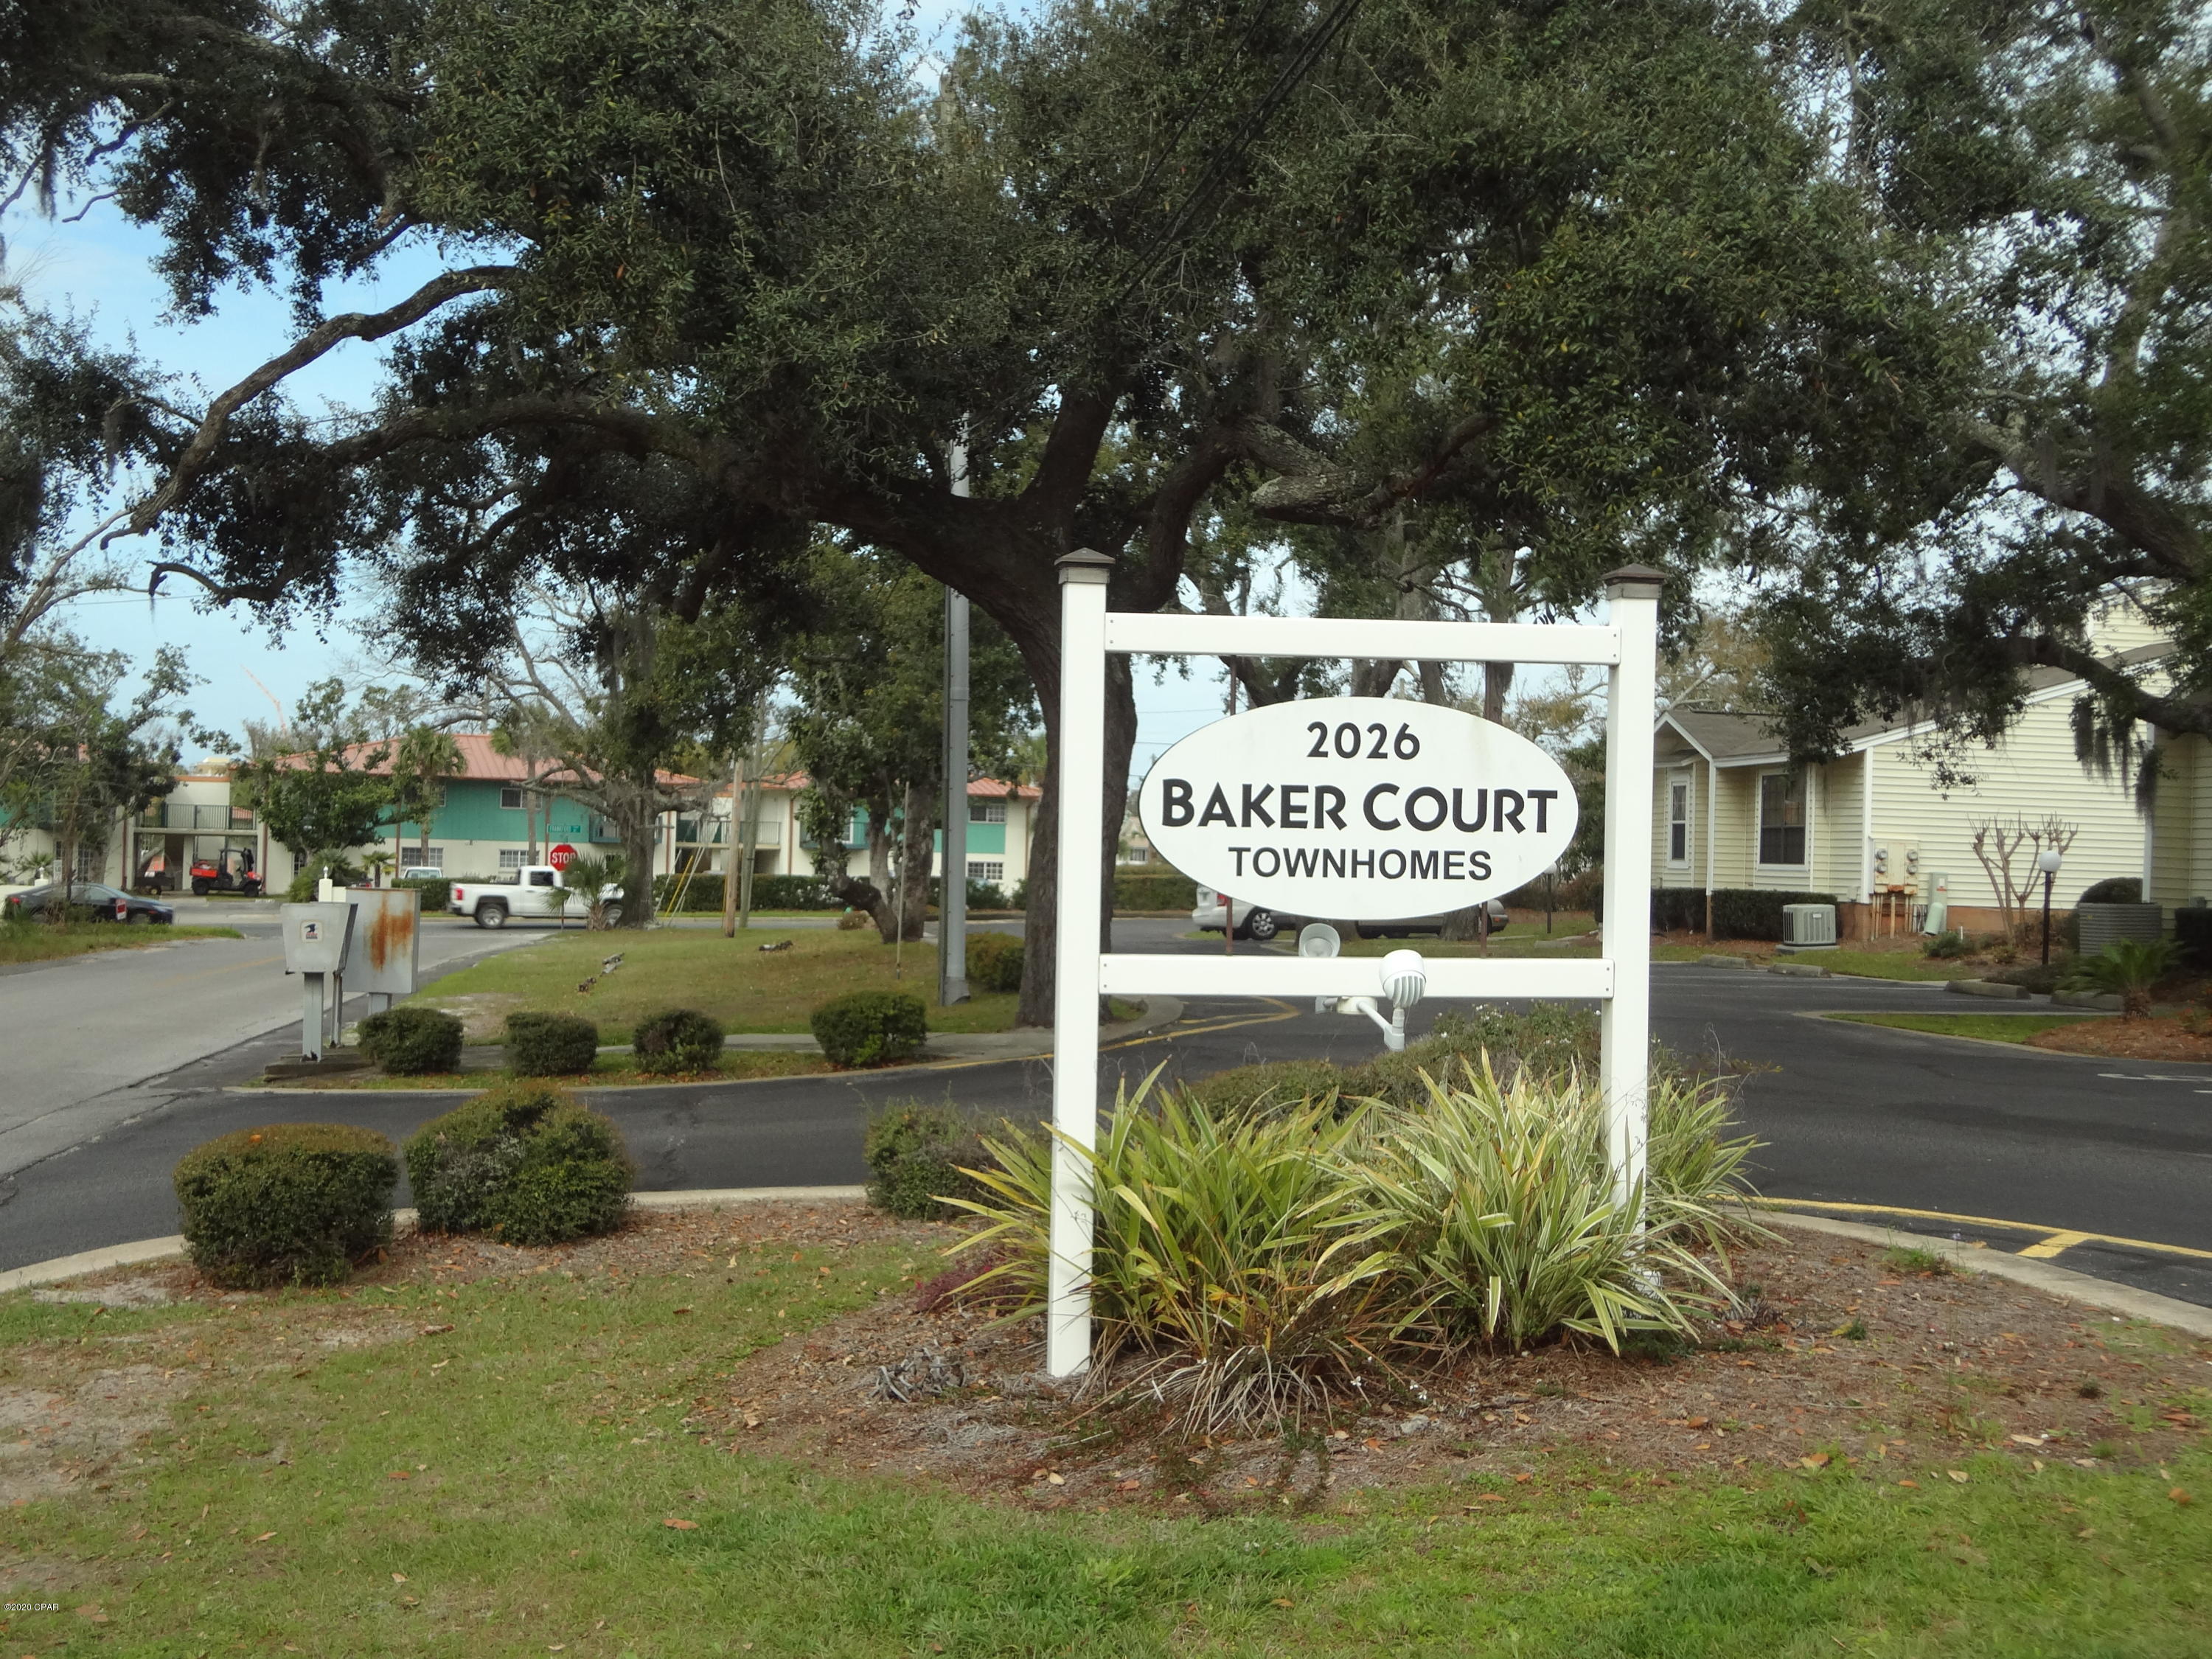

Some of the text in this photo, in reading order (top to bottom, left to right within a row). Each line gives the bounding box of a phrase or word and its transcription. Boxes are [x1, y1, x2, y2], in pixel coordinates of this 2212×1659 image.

[1307, 720, 1421, 760] 2026
[1161, 778, 1559, 834] BAKER COURT
[552, 852, 577, 864] STOP
[1228, 846, 1492, 881] TOWNHOMES
